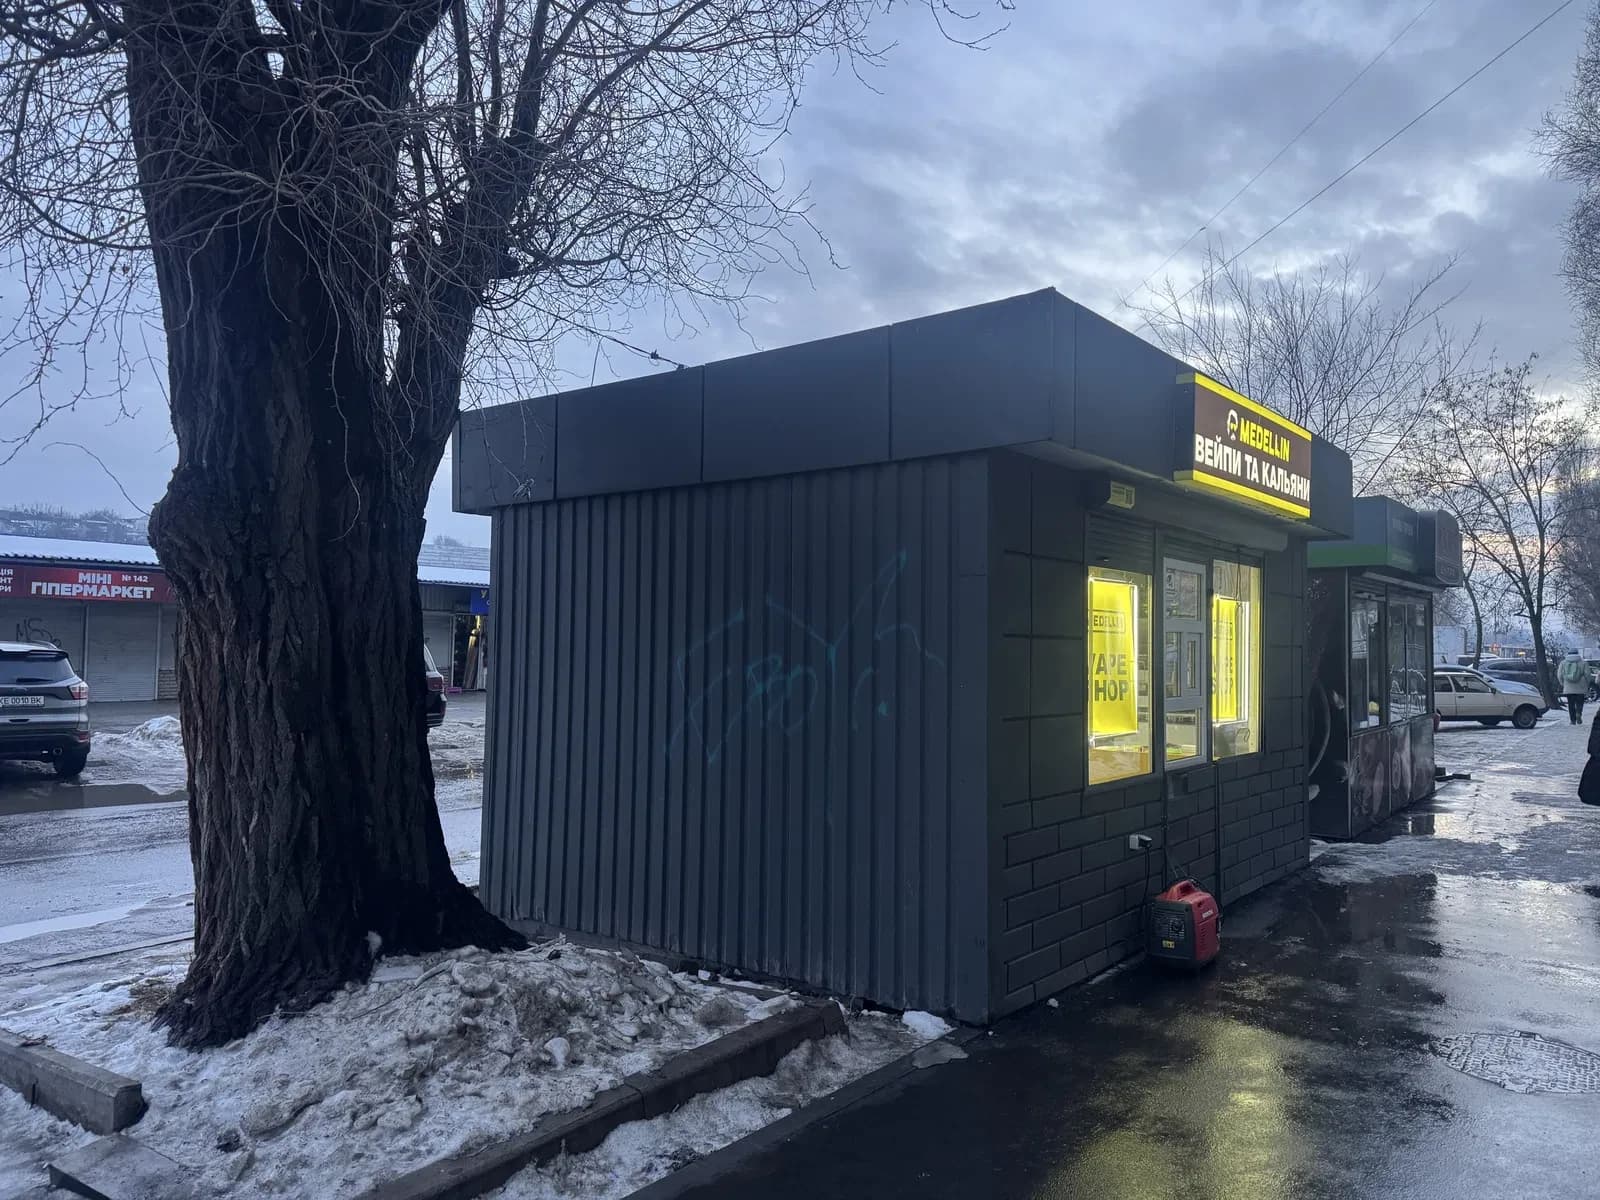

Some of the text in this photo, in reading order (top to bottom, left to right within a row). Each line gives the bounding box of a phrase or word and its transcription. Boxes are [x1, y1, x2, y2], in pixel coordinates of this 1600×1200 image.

[1240, 418, 1290, 462] MEDELLIN
[1195, 434, 1310, 502] ВЕЙПИ ТА КАЛЬЯНИ
[78, 572, 112, 585] МІНІ
[133, 575, 149, 583] 142
[31, 582, 154, 599] ГІПЕРМАРКЕТ
[1094, 679, 1129, 701] HOP
